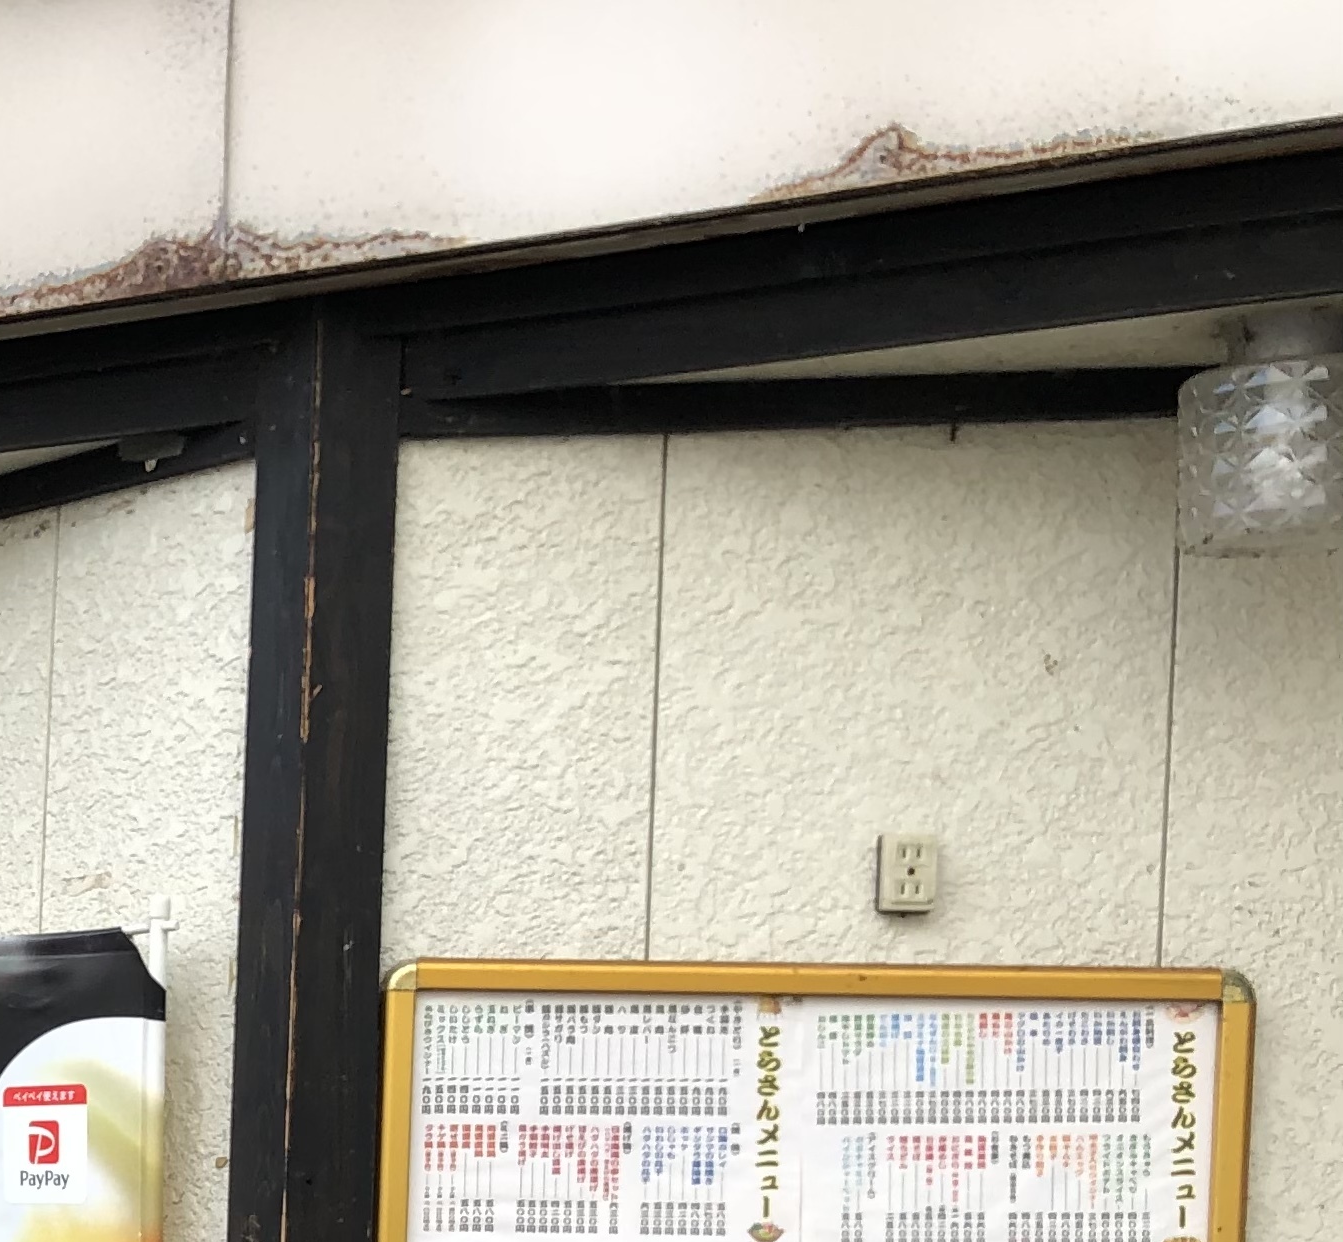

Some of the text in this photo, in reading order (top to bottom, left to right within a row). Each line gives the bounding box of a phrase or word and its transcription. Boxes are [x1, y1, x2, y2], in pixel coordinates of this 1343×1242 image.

[13, 1090, 75, 1102] ペイペイ使えます
[755, 1026, 781, 1218] とらさんメニュー
[1171, 1031, 1197, 1228] とらさんメニュー
[20, 1171, 70, 1190] PayPay
